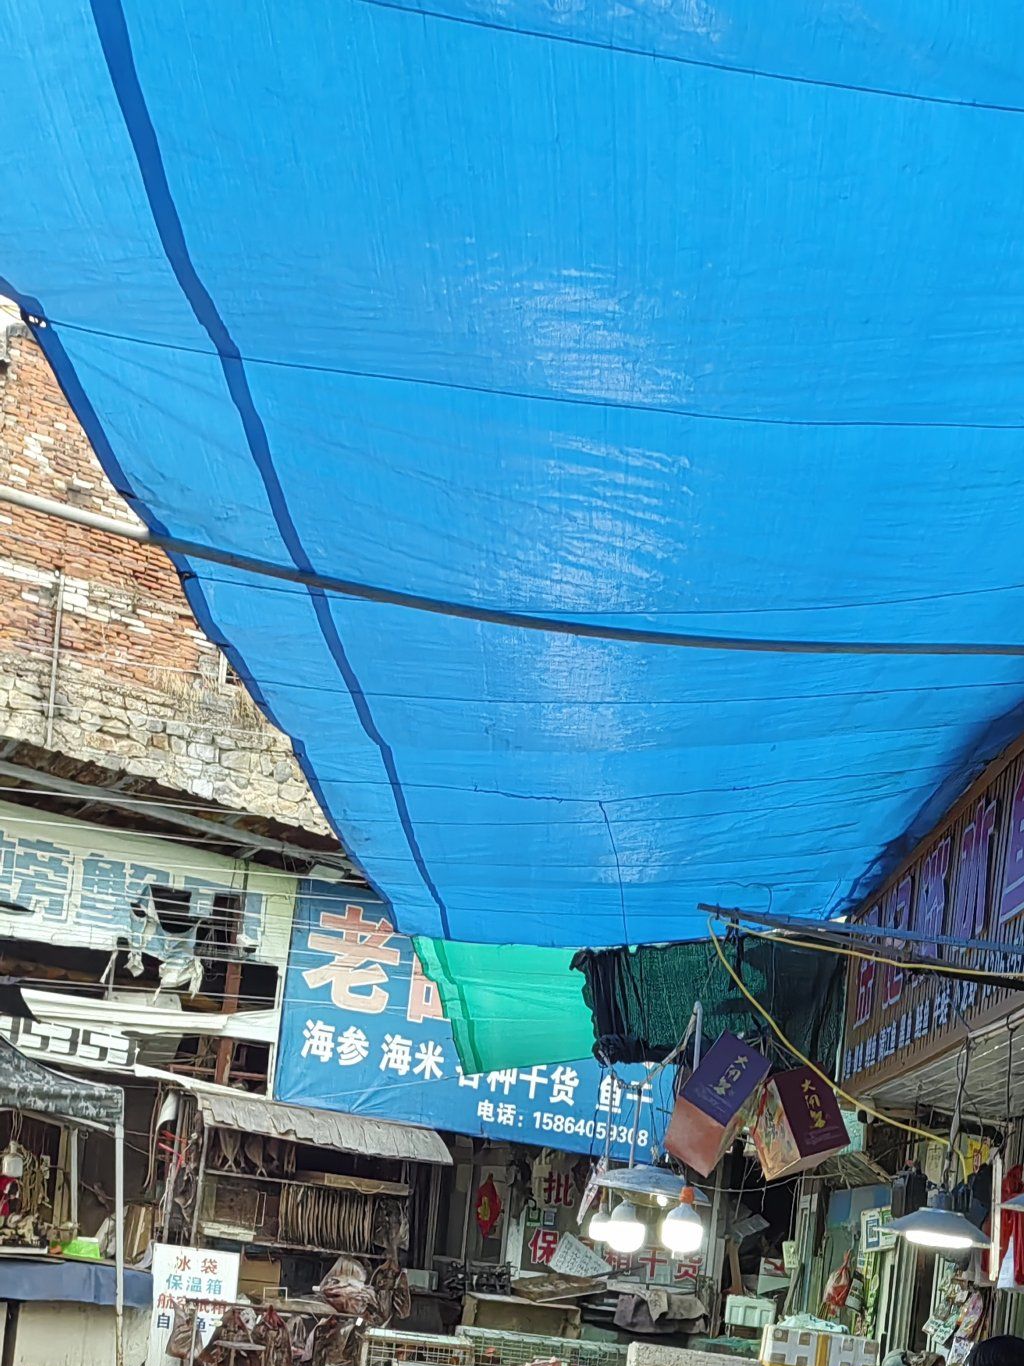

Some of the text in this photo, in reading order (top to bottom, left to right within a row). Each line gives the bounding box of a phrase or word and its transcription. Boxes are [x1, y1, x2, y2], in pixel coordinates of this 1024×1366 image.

[302, 904, 451, 1023] 老
[300, 1018, 370, 1067] 海参
[379, 1032, 445, 1080] 海米
[166, 1274, 223, 1295] 保温箱
[175, 1256, 219, 1275] 冰袋
